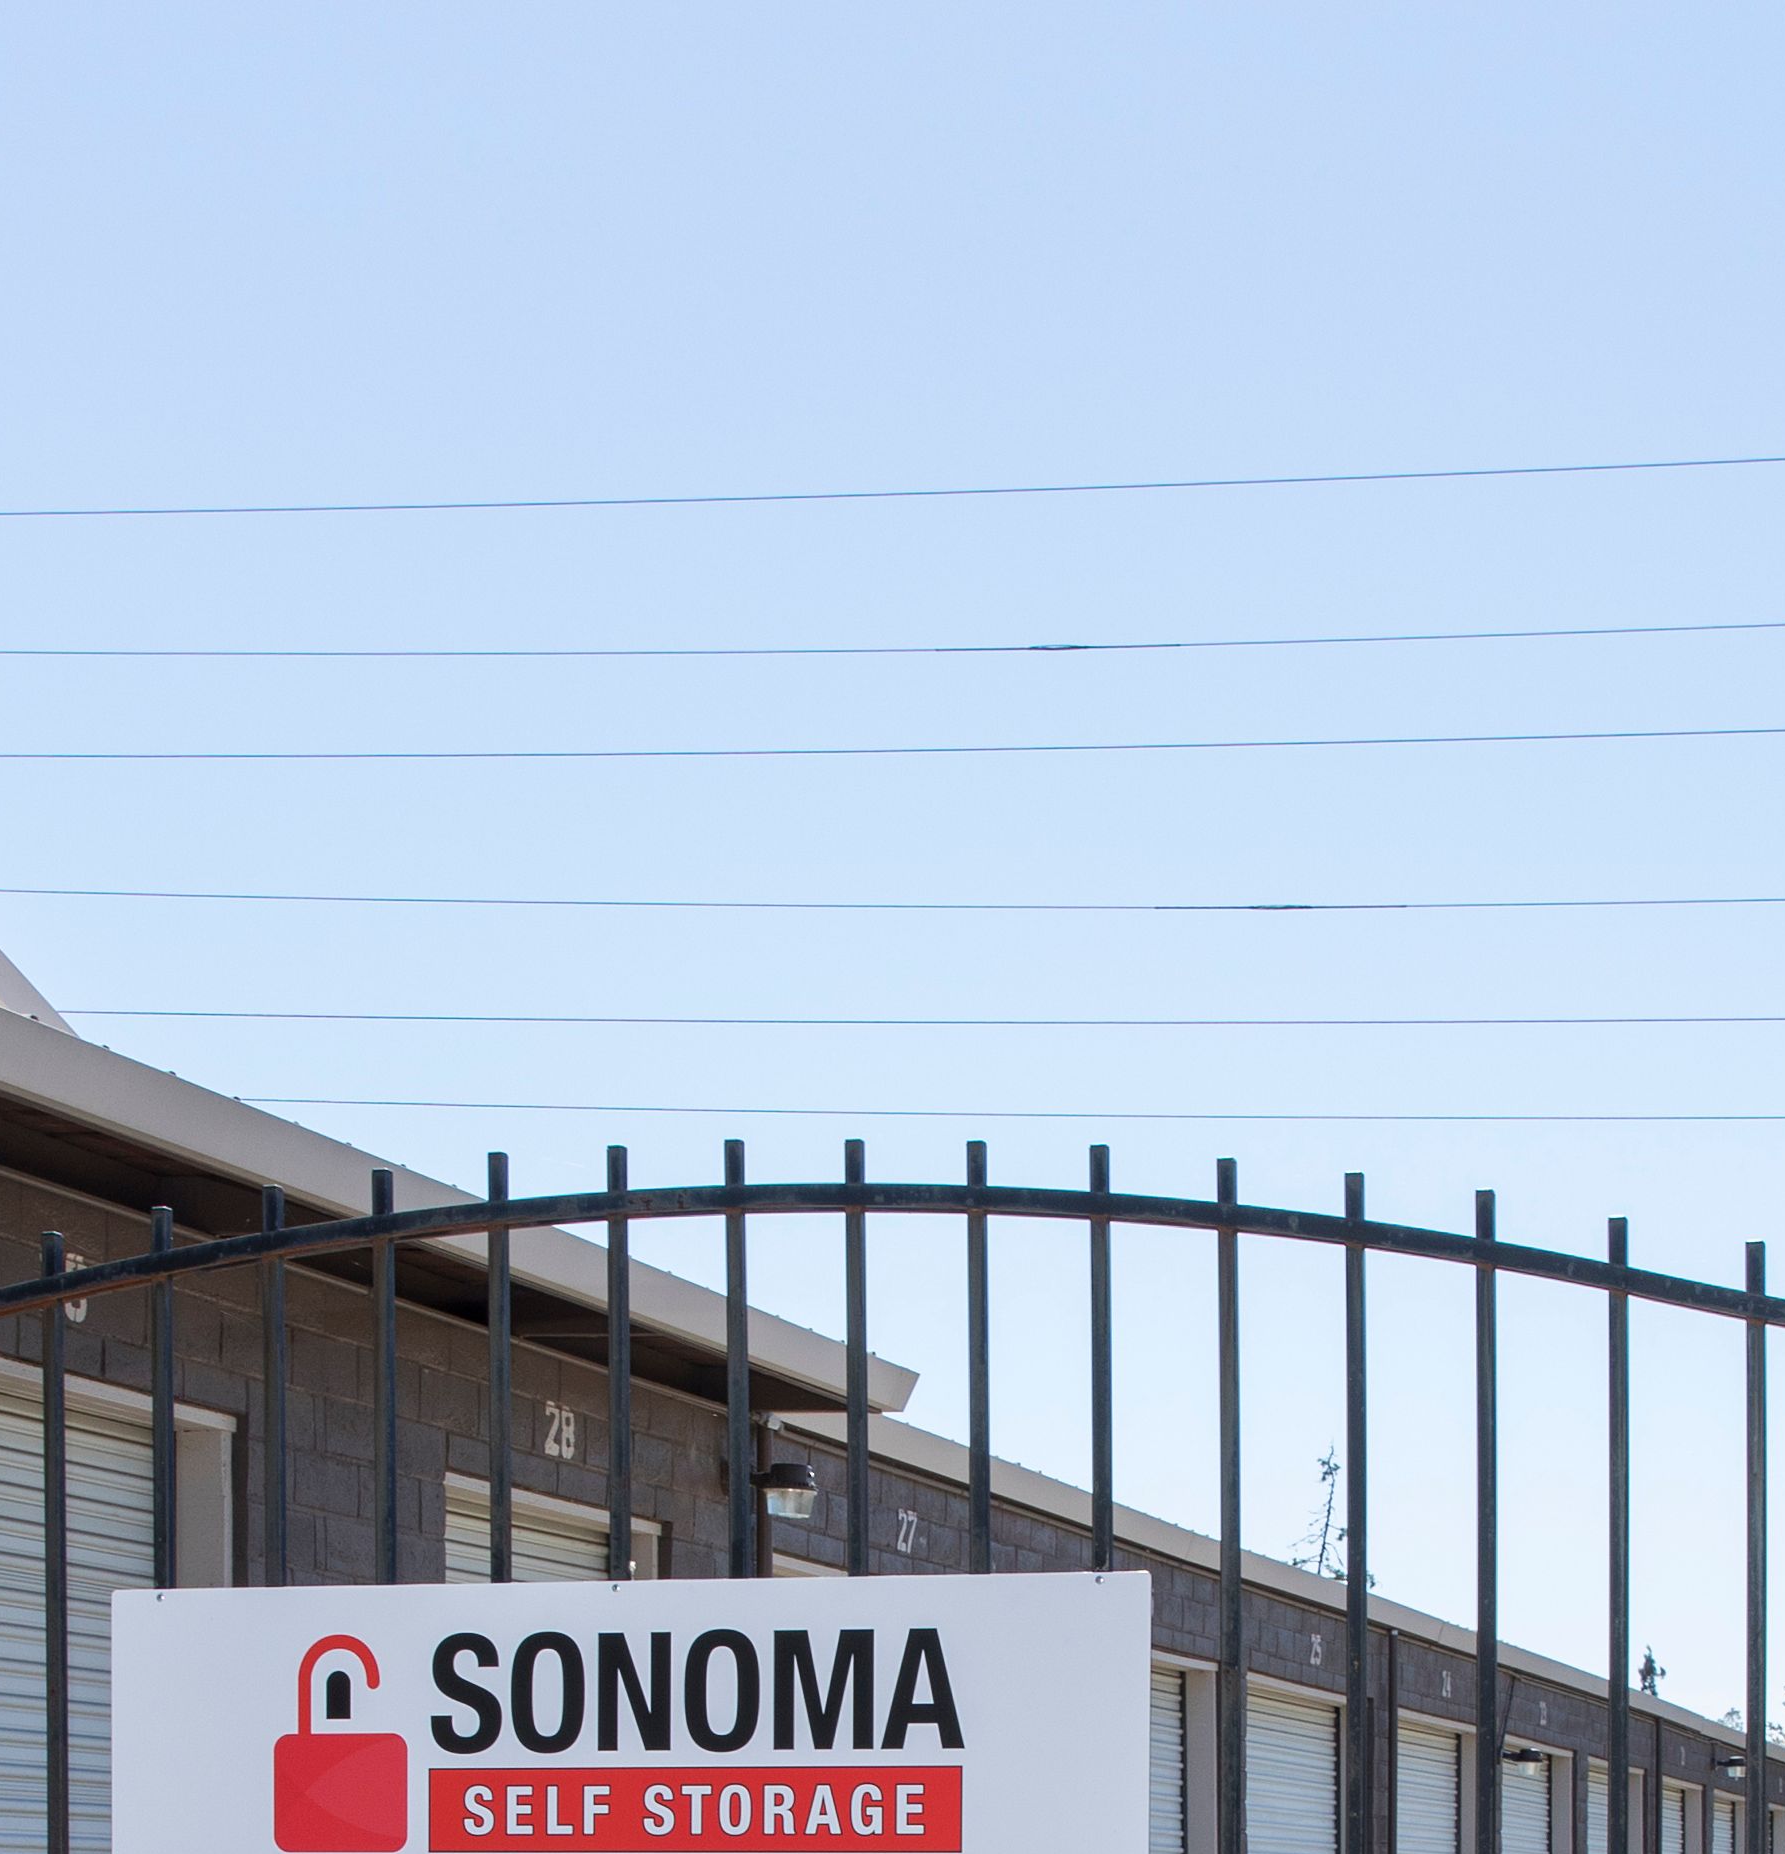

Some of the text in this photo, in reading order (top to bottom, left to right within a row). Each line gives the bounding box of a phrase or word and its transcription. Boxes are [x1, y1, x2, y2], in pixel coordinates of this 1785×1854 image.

[544, 1400, 575, 1460] 28
[897, 1508, 918, 1555] 27
[429, 1627, 966, 1755] SONOMA
[462, 1783, 926, 1837] SELF STORAGE
